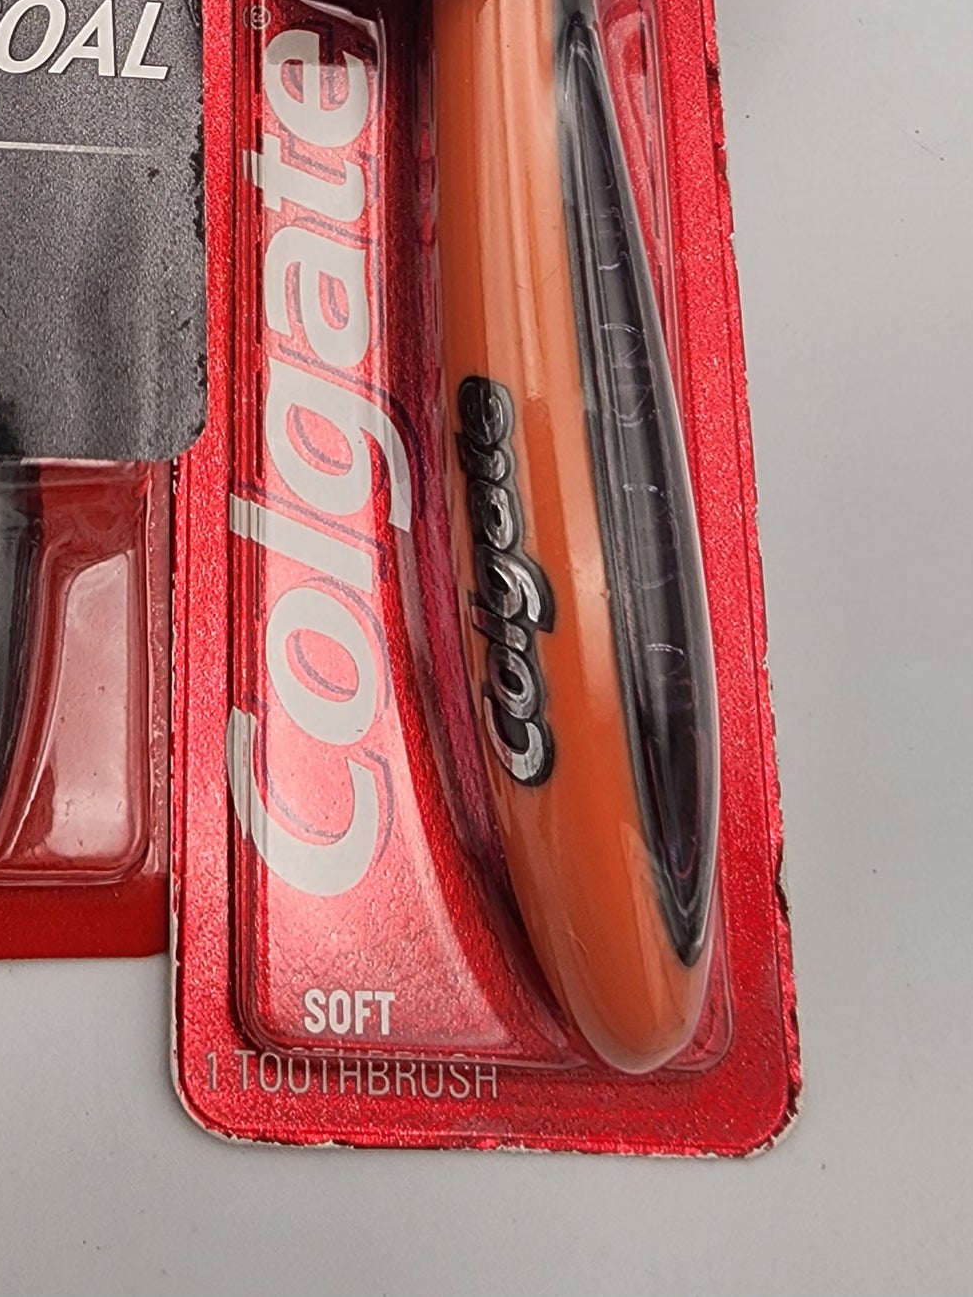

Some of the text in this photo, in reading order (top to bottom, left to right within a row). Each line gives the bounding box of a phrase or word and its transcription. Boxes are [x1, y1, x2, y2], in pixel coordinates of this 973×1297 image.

[304, 988, 395, 1035] SOFT
[206, 1048, 499, 1099] 1 TOOTHBRUSH
